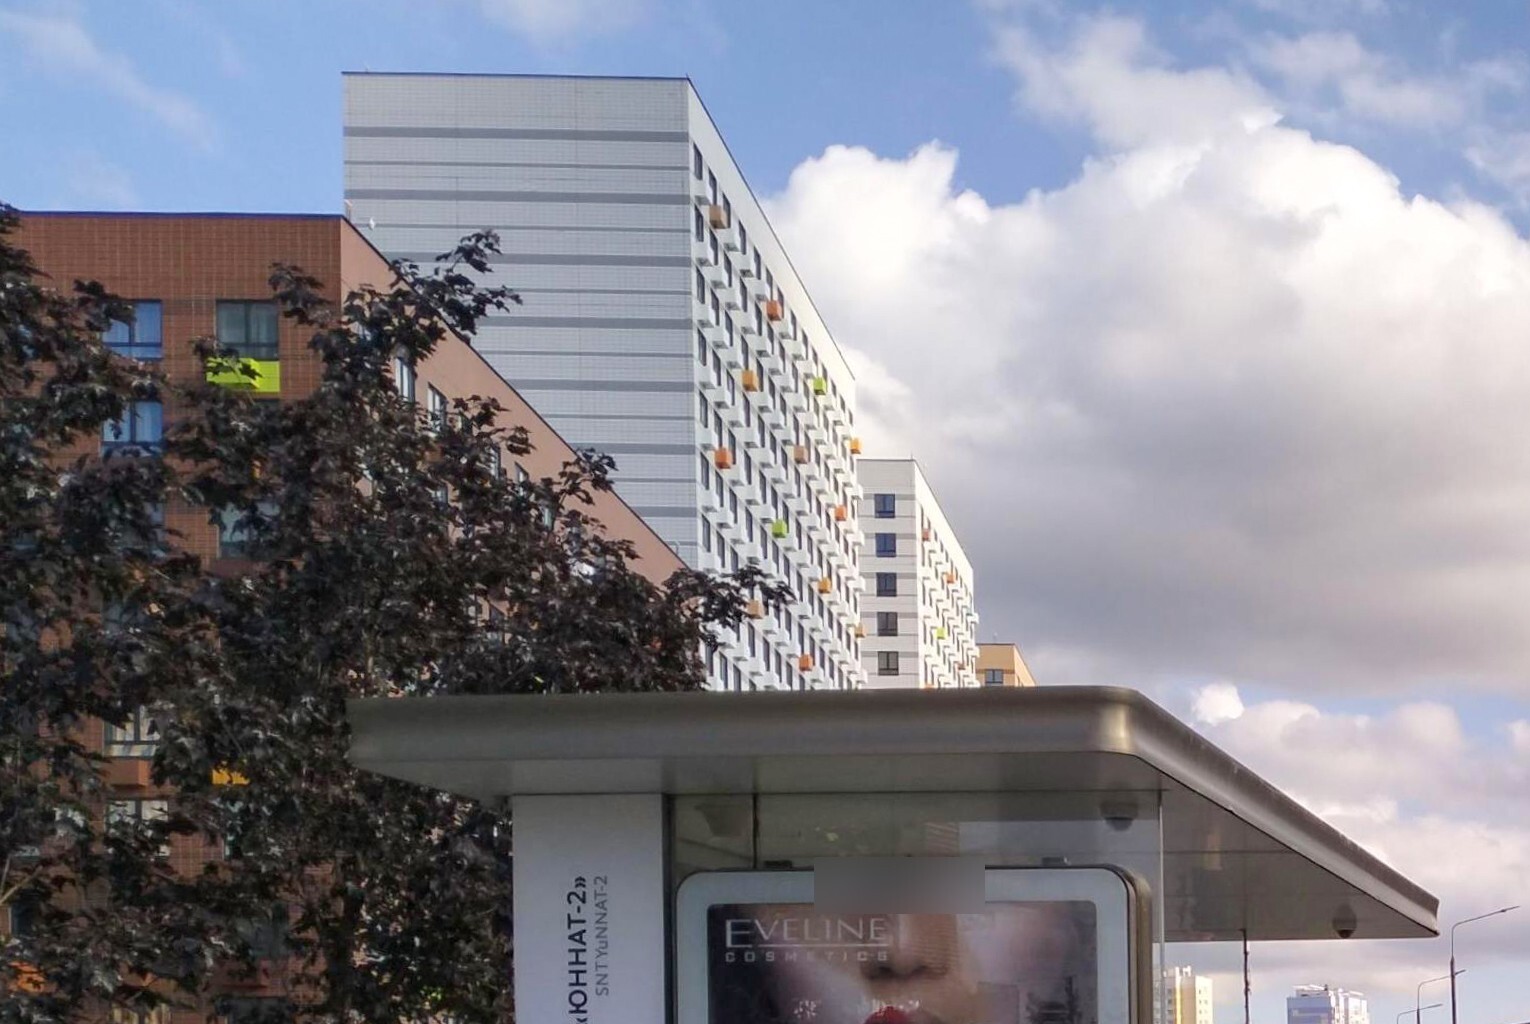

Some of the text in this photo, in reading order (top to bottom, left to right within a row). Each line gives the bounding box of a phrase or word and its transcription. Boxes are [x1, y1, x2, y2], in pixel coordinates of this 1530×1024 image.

[725, 918, 888, 949] EVELINE
[725, 951, 888, 963] COSMETICS
[595, 961, 610, 997] SNT
